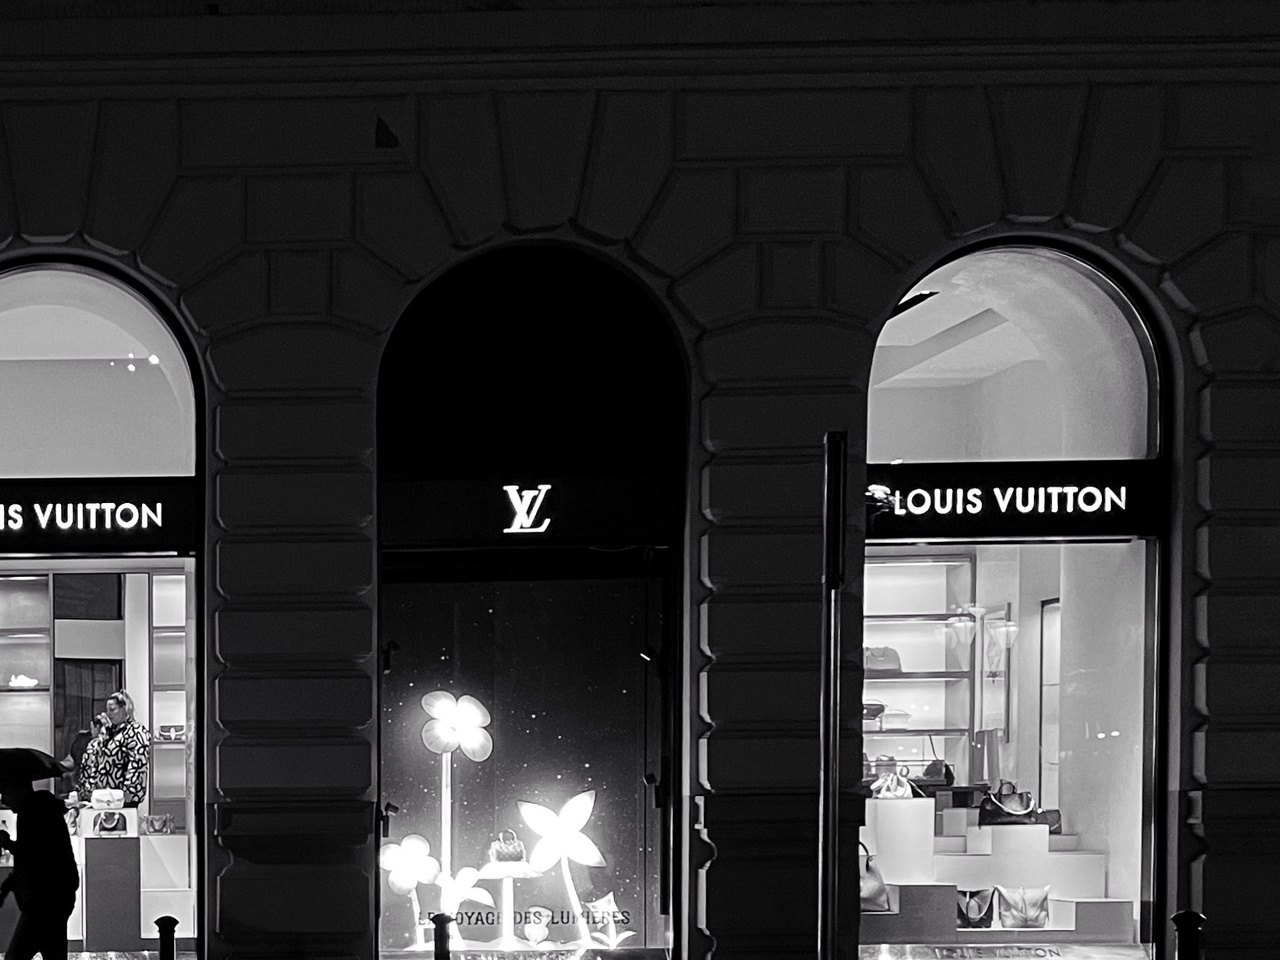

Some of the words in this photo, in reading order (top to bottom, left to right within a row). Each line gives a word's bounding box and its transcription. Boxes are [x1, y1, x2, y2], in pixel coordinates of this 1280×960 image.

[894, 488, 983, 515] LOUIS
[993, 486, 1126, 513] VUITTON
[33, 502, 163, 529] VUITTON
[514, 910, 543, 925] DES
